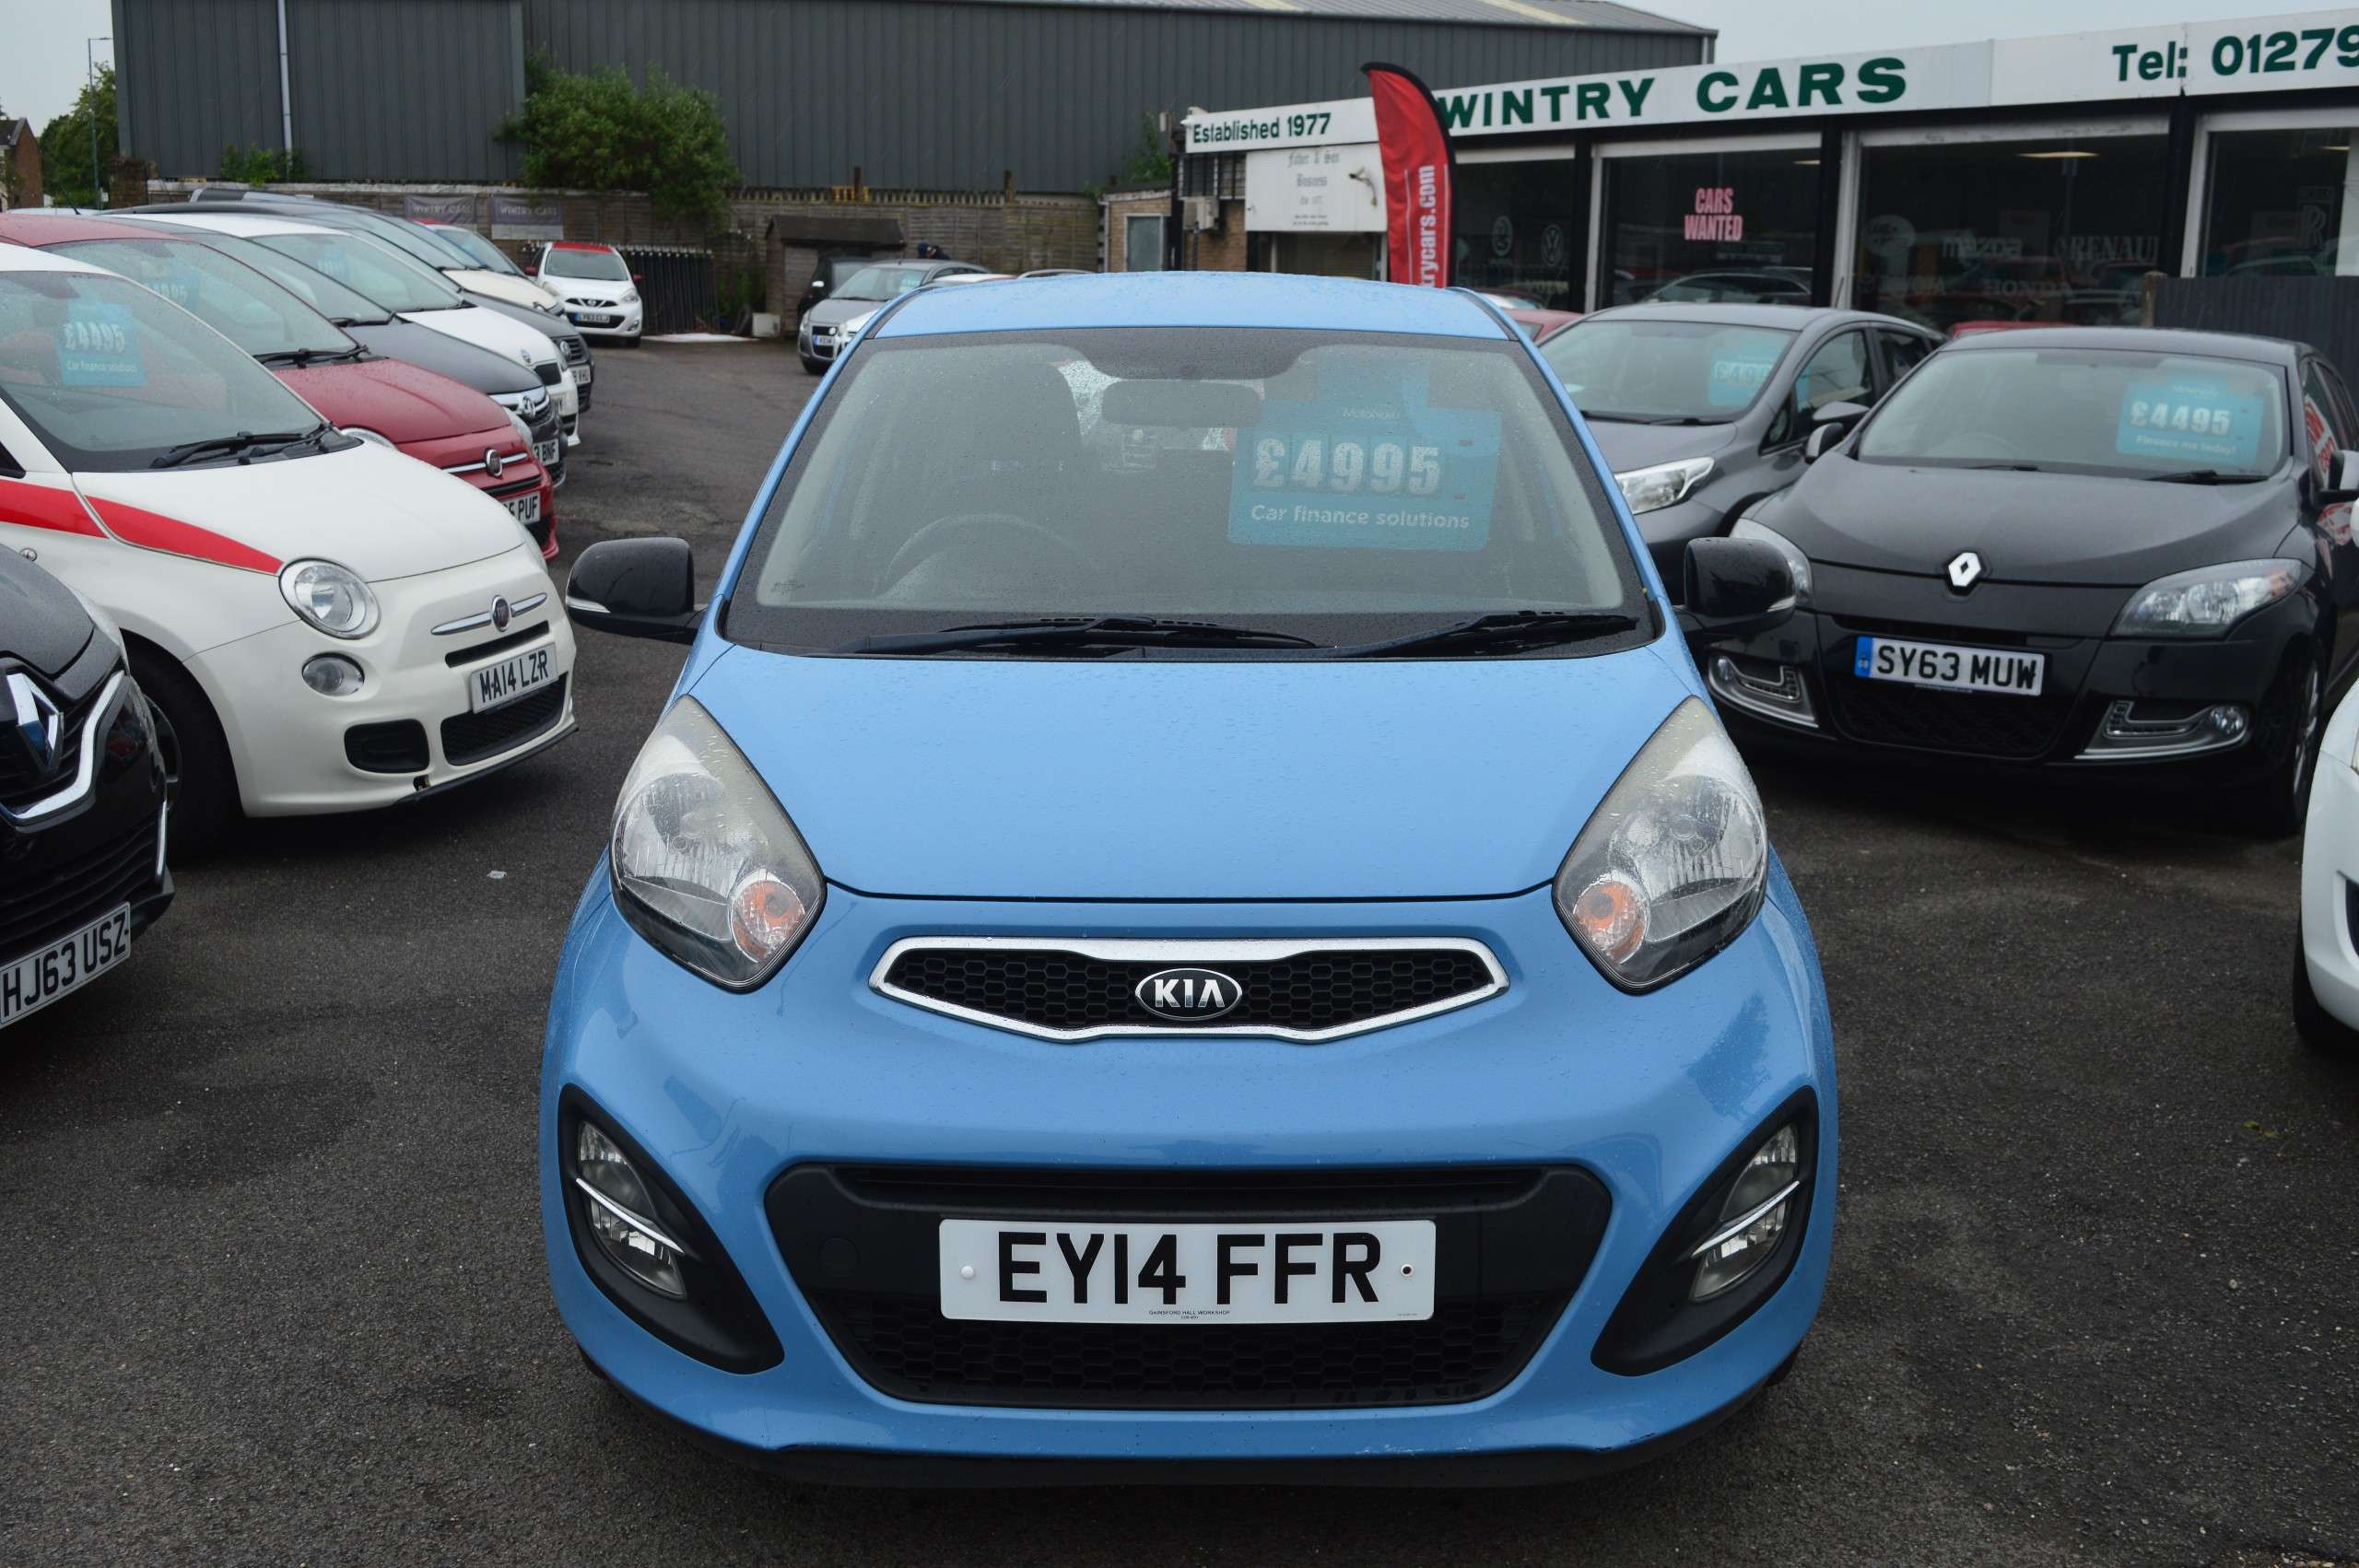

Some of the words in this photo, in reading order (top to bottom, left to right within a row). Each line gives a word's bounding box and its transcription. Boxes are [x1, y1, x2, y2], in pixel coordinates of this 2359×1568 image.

[2112, 41, 2189, 82] Tel:
[2212, 25, 2359, 76] 01279
[1436, 76, 1656, 130] WINTRY
[1696, 56, 1907, 113] CARS
[1192, 117, 1280, 144] Established
[1287, 111, 1332, 137] 1977
[1695, 187, 1734, 215] CARS
[1684, 215, 1743, 241] WANTED
[2130, 400, 2230, 437] £4495
[542, 442, 556, 462] BNF
[1254, 438, 1441, 496] £4995
[518, 496, 539, 521] PUF
[1251, 505, 1288, 521] Car
[1294, 505, 1369, 525] finance
[1376, 509, 1470, 529] solutions
[479, 661, 517, 703] MA14
[519, 649, 549, 688] LZR
[1876, 644, 1961, 682] SY63
[1969, 654, 2037, 690] MUW
[3, 941, 76, 1018] HJ63
[83, 911, 127, 975] USZ
[1154, 978, 1226, 1008] KIA
[998, 1231, 1187, 1305] EY14
[1216, 1232, 1381, 1305] FFR
